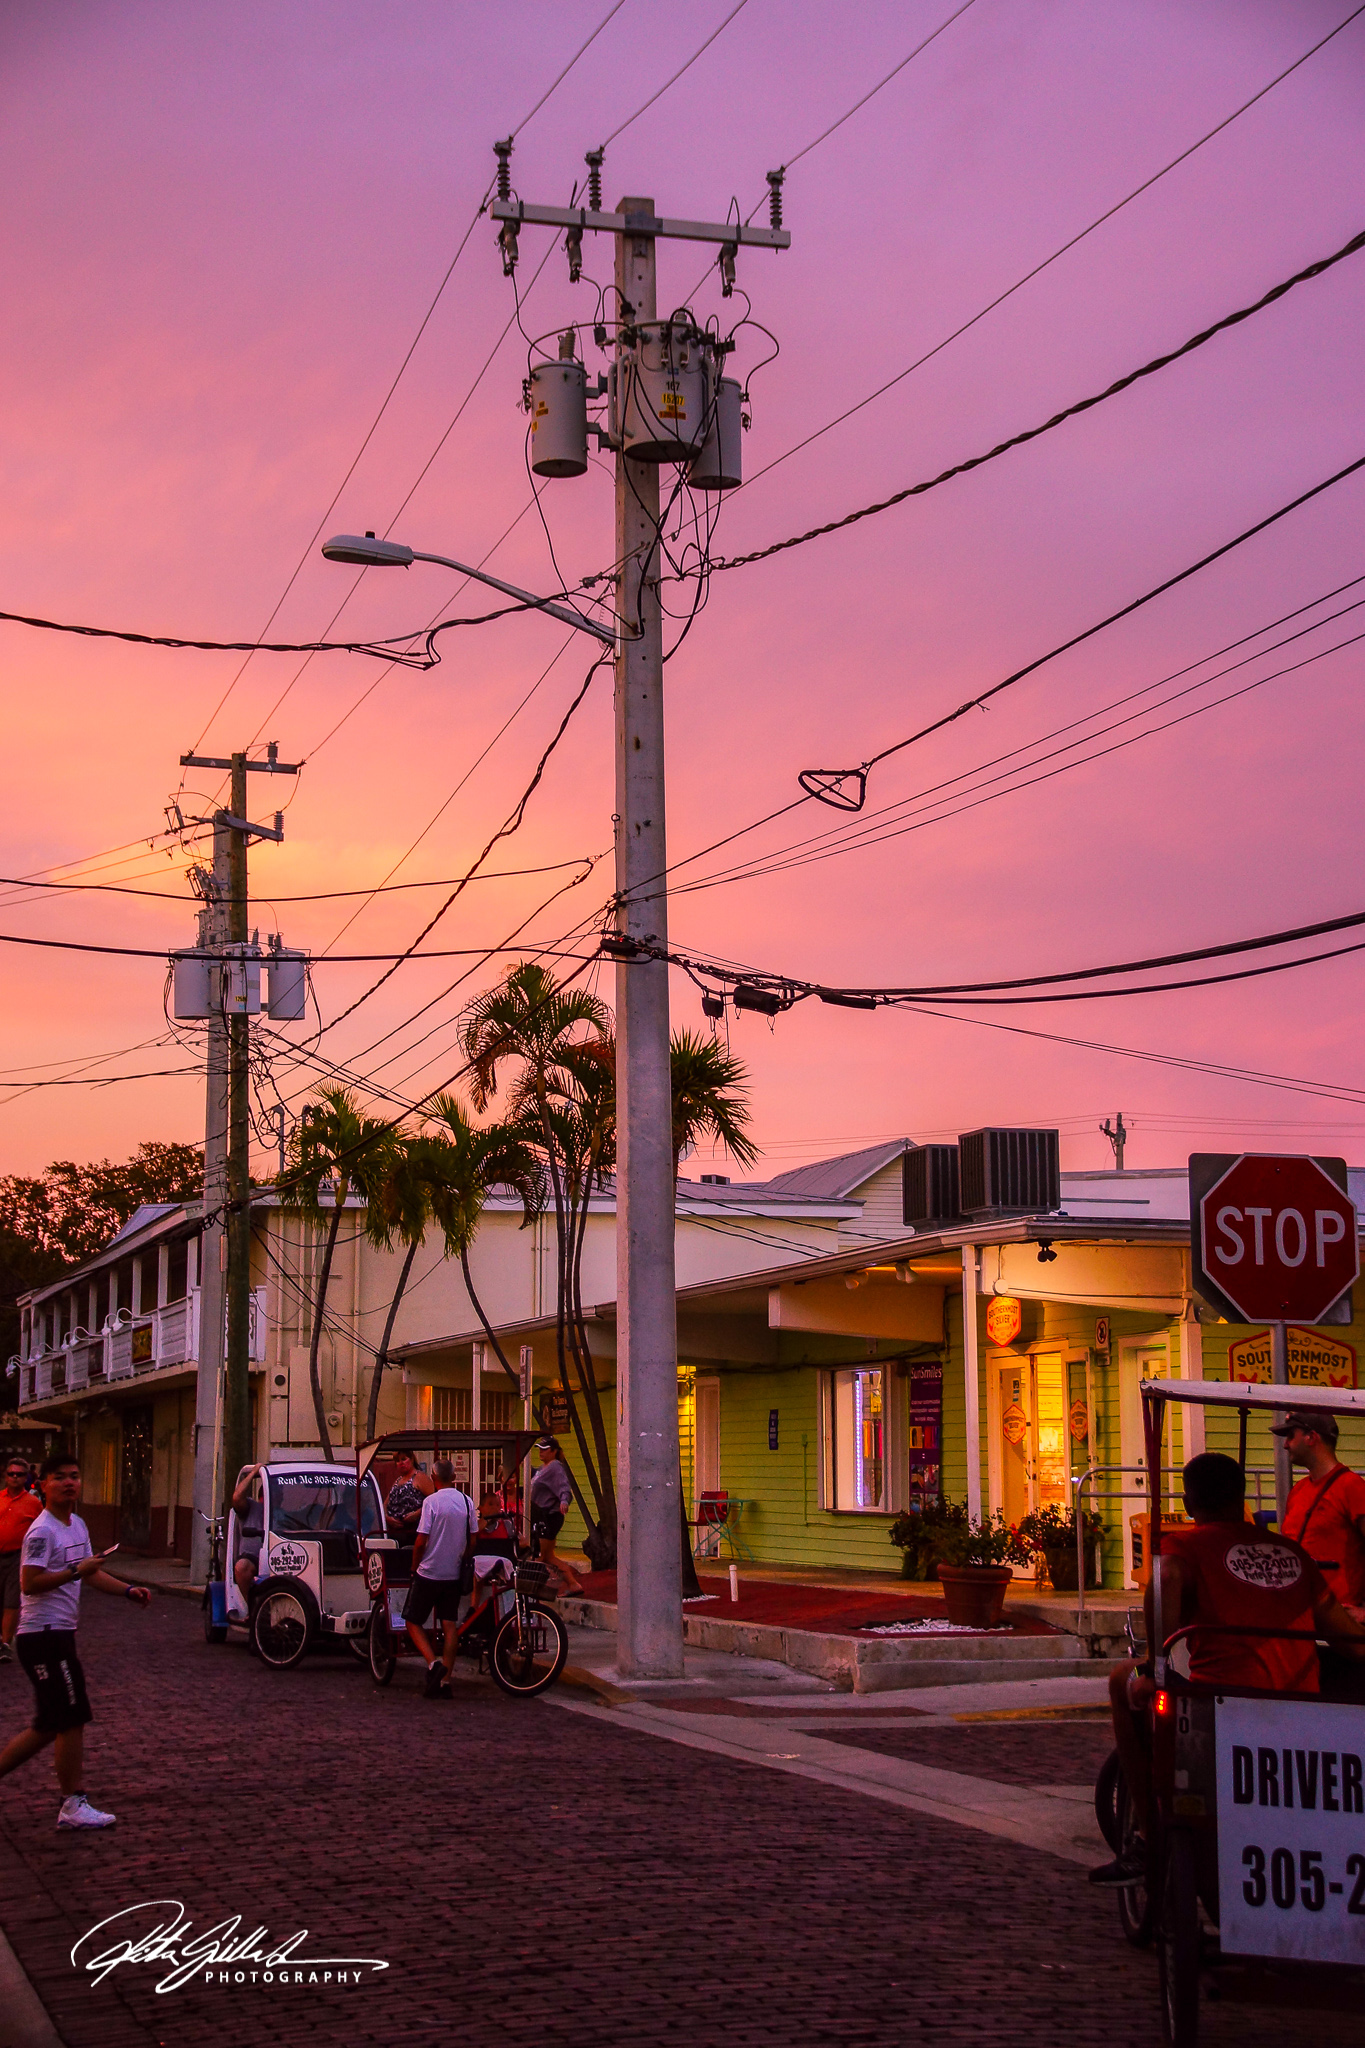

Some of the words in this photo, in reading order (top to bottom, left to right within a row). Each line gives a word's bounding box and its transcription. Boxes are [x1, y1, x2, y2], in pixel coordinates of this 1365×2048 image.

[1214, 1205, 1346, 1268] STOP
[995, 1314, 1010, 1325] SILVER
[1237, 1349, 1349, 1369] SOUTRNMOST
[910, 1365, 942, 1379] SunSmiles
[277, 1476, 297, 1486] Rent
[299, 1475, 312, 1485] Me
[1232, 1745, 1364, 1813] DRIVER
[1242, 1844, 1365, 1915] 305-2
